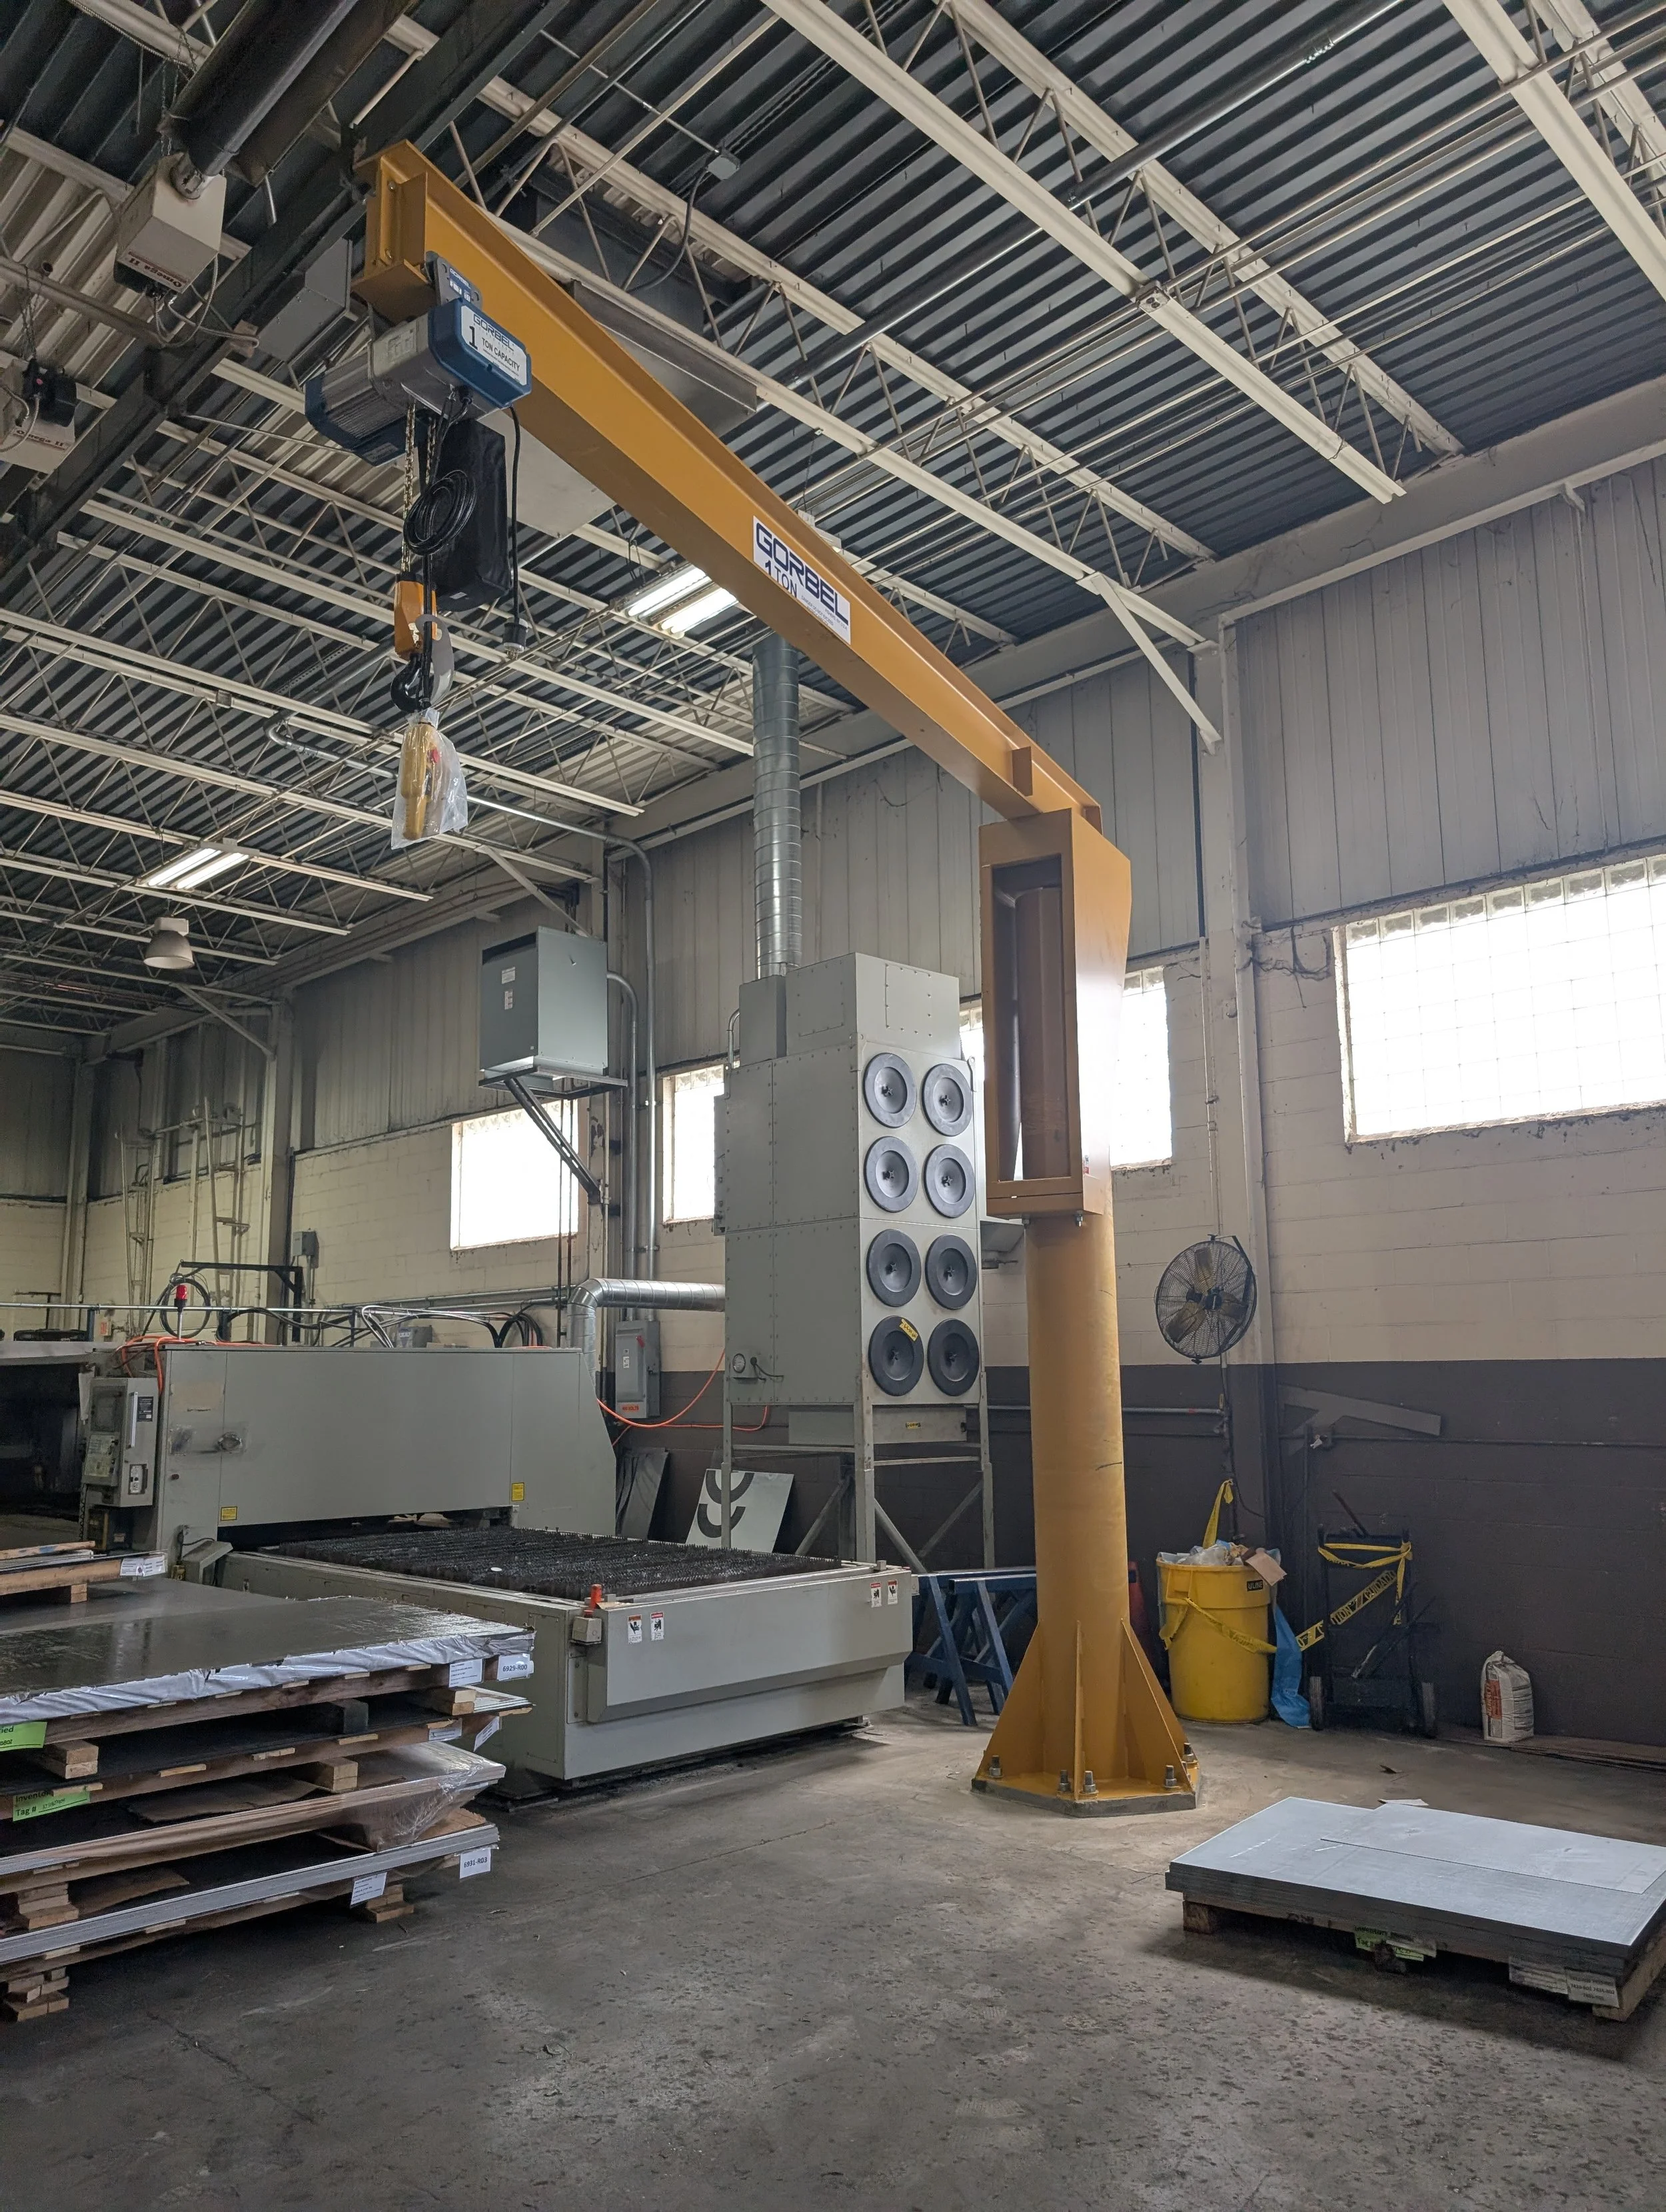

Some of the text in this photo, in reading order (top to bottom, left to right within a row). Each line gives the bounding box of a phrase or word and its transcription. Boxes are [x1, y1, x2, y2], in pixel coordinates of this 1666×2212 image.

[145, 265, 182, 287] Omega
[450, 268, 471, 289] GORBEL
[473, 314, 514, 352] GORBEL
[469, 325, 478, 350] 1
[482, 337, 493, 352] TON
[494, 346, 520, 372] CAPACITY
[756, 522, 849, 626] GORBEL
[765, 560, 798, 598] 1 TON
[15, 1808, 30, 1816] Tag
[463, 1857, 488, 1868] 6931-R03
